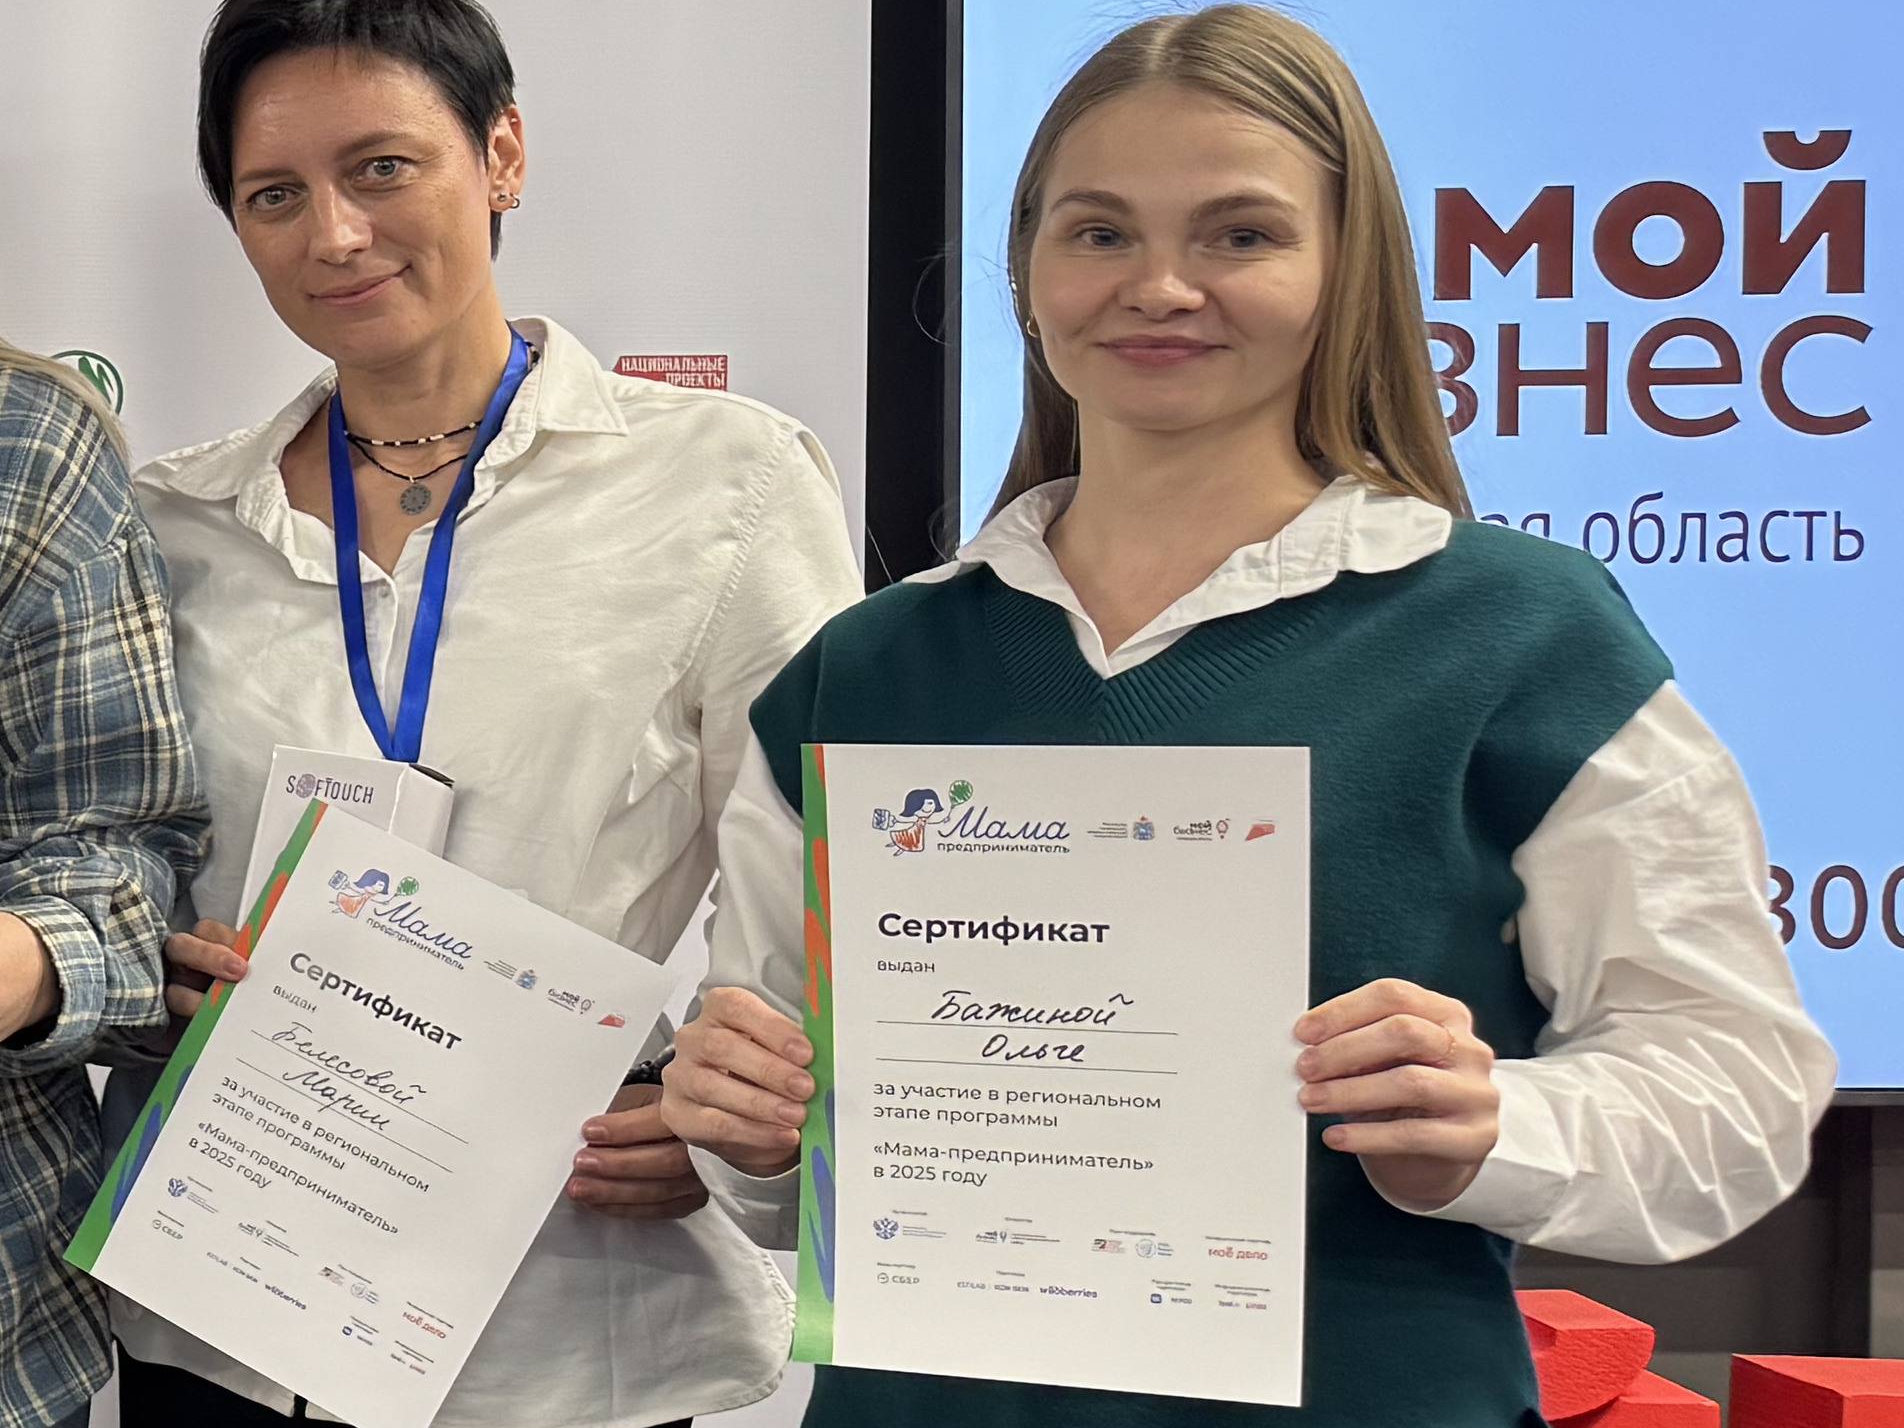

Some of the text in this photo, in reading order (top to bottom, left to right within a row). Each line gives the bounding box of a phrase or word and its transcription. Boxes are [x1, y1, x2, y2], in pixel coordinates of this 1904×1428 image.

[1433, 129, 1866, 301] мой
[621, 357, 726, 372] НАЦИОНАЛЬНЫЕ
[1583, 490, 1865, 564] область
[938, 804, 1070, 840] Мама
[372, 900, 474, 959] Мама
[878, 912, 1110, 946] Сертификат
[877, 960, 934, 974] выдан
[272, 984, 317, 1012] выдан
[290, 952, 462, 1049] Сертификат
[930, 989, 1133, 1025] Бажиной
[981, 1033, 1084, 1062] Ольге
[281, 1070, 390, 1130] Марии
[873, 1083, 1160, 1108] за участие в региональном
[211, 1092, 345, 1169] этапе программы
[221, 1076, 429, 1192] за участие в региональном
[873, 1106, 1057, 1127] этапе программы
[188, 1137, 271, 1188] в 2025 году
[873, 1163, 987, 1187] в 2025 году
